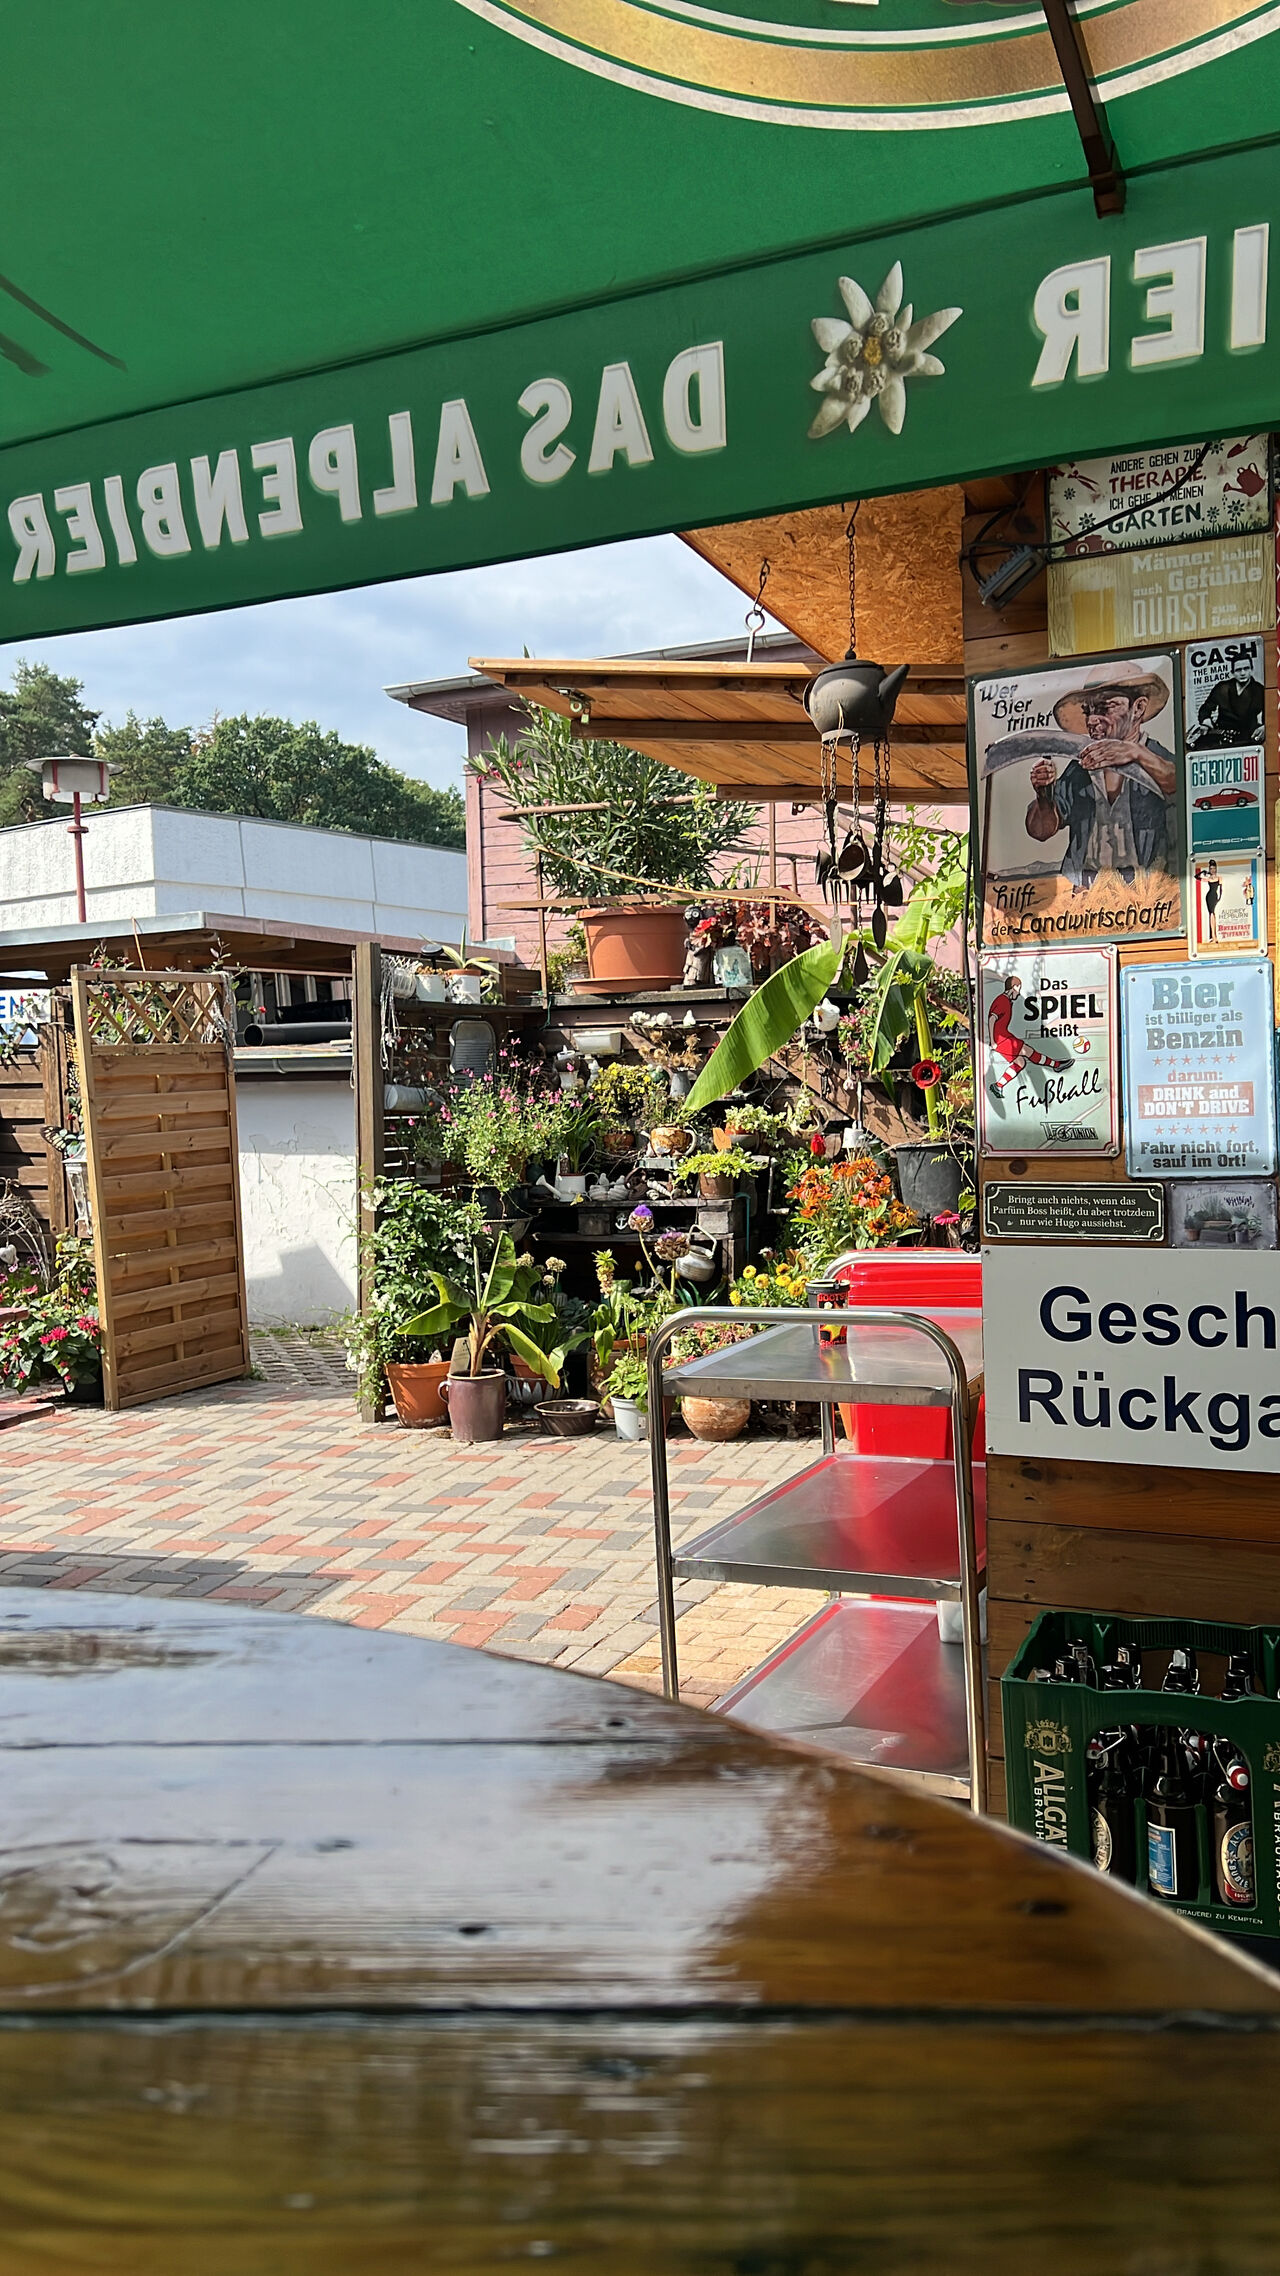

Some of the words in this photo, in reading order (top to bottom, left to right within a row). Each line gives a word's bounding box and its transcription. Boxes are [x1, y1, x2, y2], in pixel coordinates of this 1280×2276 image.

[1110, 457, 1144, 475] ANDERE
[1149, 452, 1179, 467] GEHEN
[1109, 498, 1123, 511] ICH
[1169, 485, 1204, 501] MEINEN
[1107, 502, 1205, 534] GARTEN.
[1131, 551, 1214, 574] Männer
[1221, 549, 1261, 561] haben
[1133, 583, 1163, 596] auch
[1168, 562, 1263, 592] Gefühle
[1133, 591, 1208, 638] DURST
[1211, 611, 1262, 627] Beispiel
[1191, 641, 1257, 667] CASH
[1193, 668, 1208, 677] THE
[1211, 665, 1228, 674] MAN
[1194, 677, 1202, 685] IN
[1205, 672, 1230, 684] BLACK
[980, 684, 1018, 702] Wer
[992, 699, 1033, 719] Bier
[1007, 711, 1052, 732] trinkt
[1244, 756, 1258, 781] 911
[1193, 836, 1260, 846] PORSCHE
[993, 883, 1035, 913] hilft
[991, 923, 1013, 937] der
[1013, 900, 1172, 935] Landwirtschaft!
[1040, 978, 1068, 991] Das
[1152, 976, 1235, 1010] Bier
[1024, 994, 1104, 1021] SPIEL
[1145, 1014, 1163, 1026] ist
[1167, 1012, 1217, 1026] billiger
[1221, 1010, 1243, 1022] als
[1040, 1024, 1079, 1038] heißt
[1146, 1024, 1244, 1050] Benzin
[1167, 1070, 1223, 1082] darum:
[1016, 1067, 1102, 1114] Fußball
[1152, 1086, 1205, 1101] DRINK
[1208, 1085, 1239, 1099] and
[1198, 1099, 1250, 1114] DRIVE
[1140, 1141, 1176, 1155] Fahr
[1181, 1140, 1221, 1153] nicht
[1226, 1140, 1260, 1154] fort,
[1152, 1155, 1187, 1168] sauf
[1192, 1155, 1212, 1167] im
[1217, 1154, 1246, 1167] Ort!
[1008, 1195, 1036, 1205] Bringt
[1037, 1195, 1059, 1205] auch
[1061, 1196, 1091, 1205] nichts,
[1120, 1196, 1136, 1205] das
[993, 1205, 1025, 1215] Parfüm
[1027, 1206, 1048, 1215] Boss
[1049, 1206, 1075, 1217] heißt,
[1077, 1207, 1090, 1216] du
[1091, 1207, 1112, 1216] aber
[1113, 1208, 1155, 1217] trotzdem
[1037, 1218, 1054, 1226] wie
[1055, 1218, 1080, 1228] Hugo
[1081, 1218, 1127, 1228] aussiehst.
[1040, 1285, 1276, 1349] Gesch
[1228, 1914, 1263, 1925] KEMPTEN
